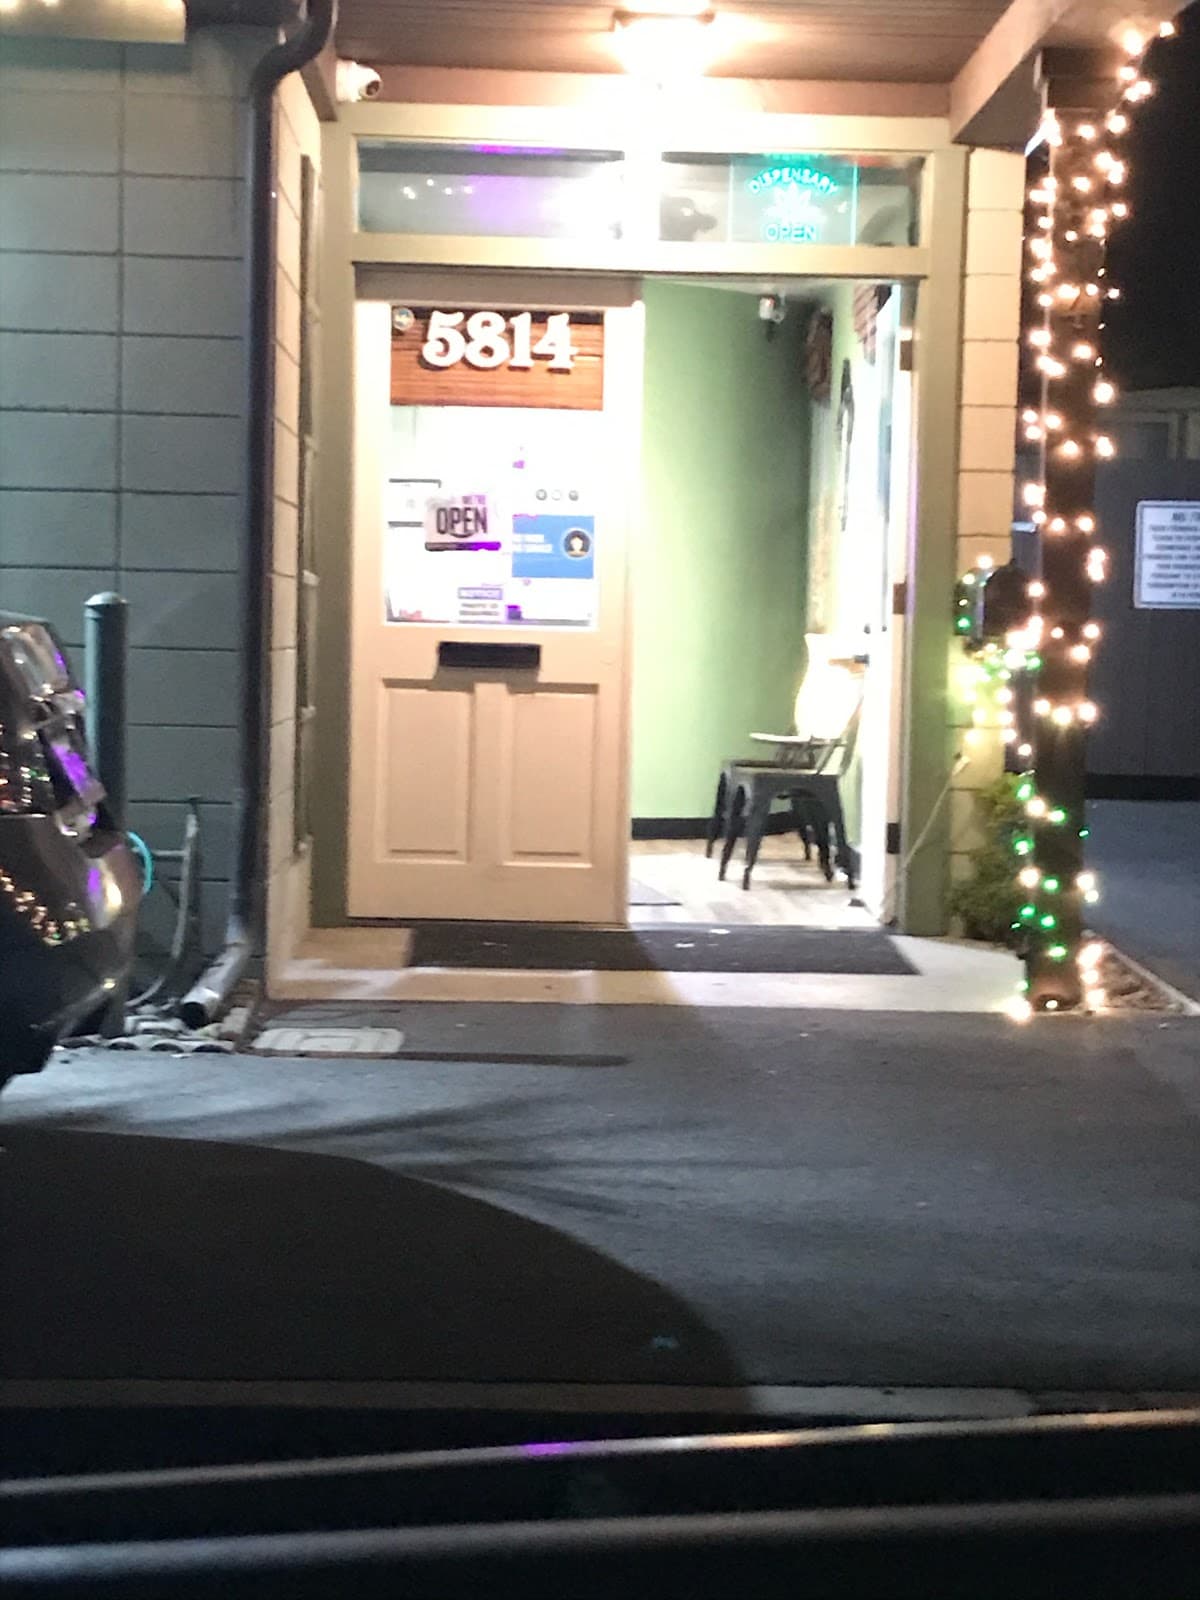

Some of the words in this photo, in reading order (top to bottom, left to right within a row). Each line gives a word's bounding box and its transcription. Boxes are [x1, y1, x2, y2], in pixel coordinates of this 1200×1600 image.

[765, 223, 817, 241] OPEN
[422, 310, 579, 370] 5814
[436, 506, 488, 536] OPEN
